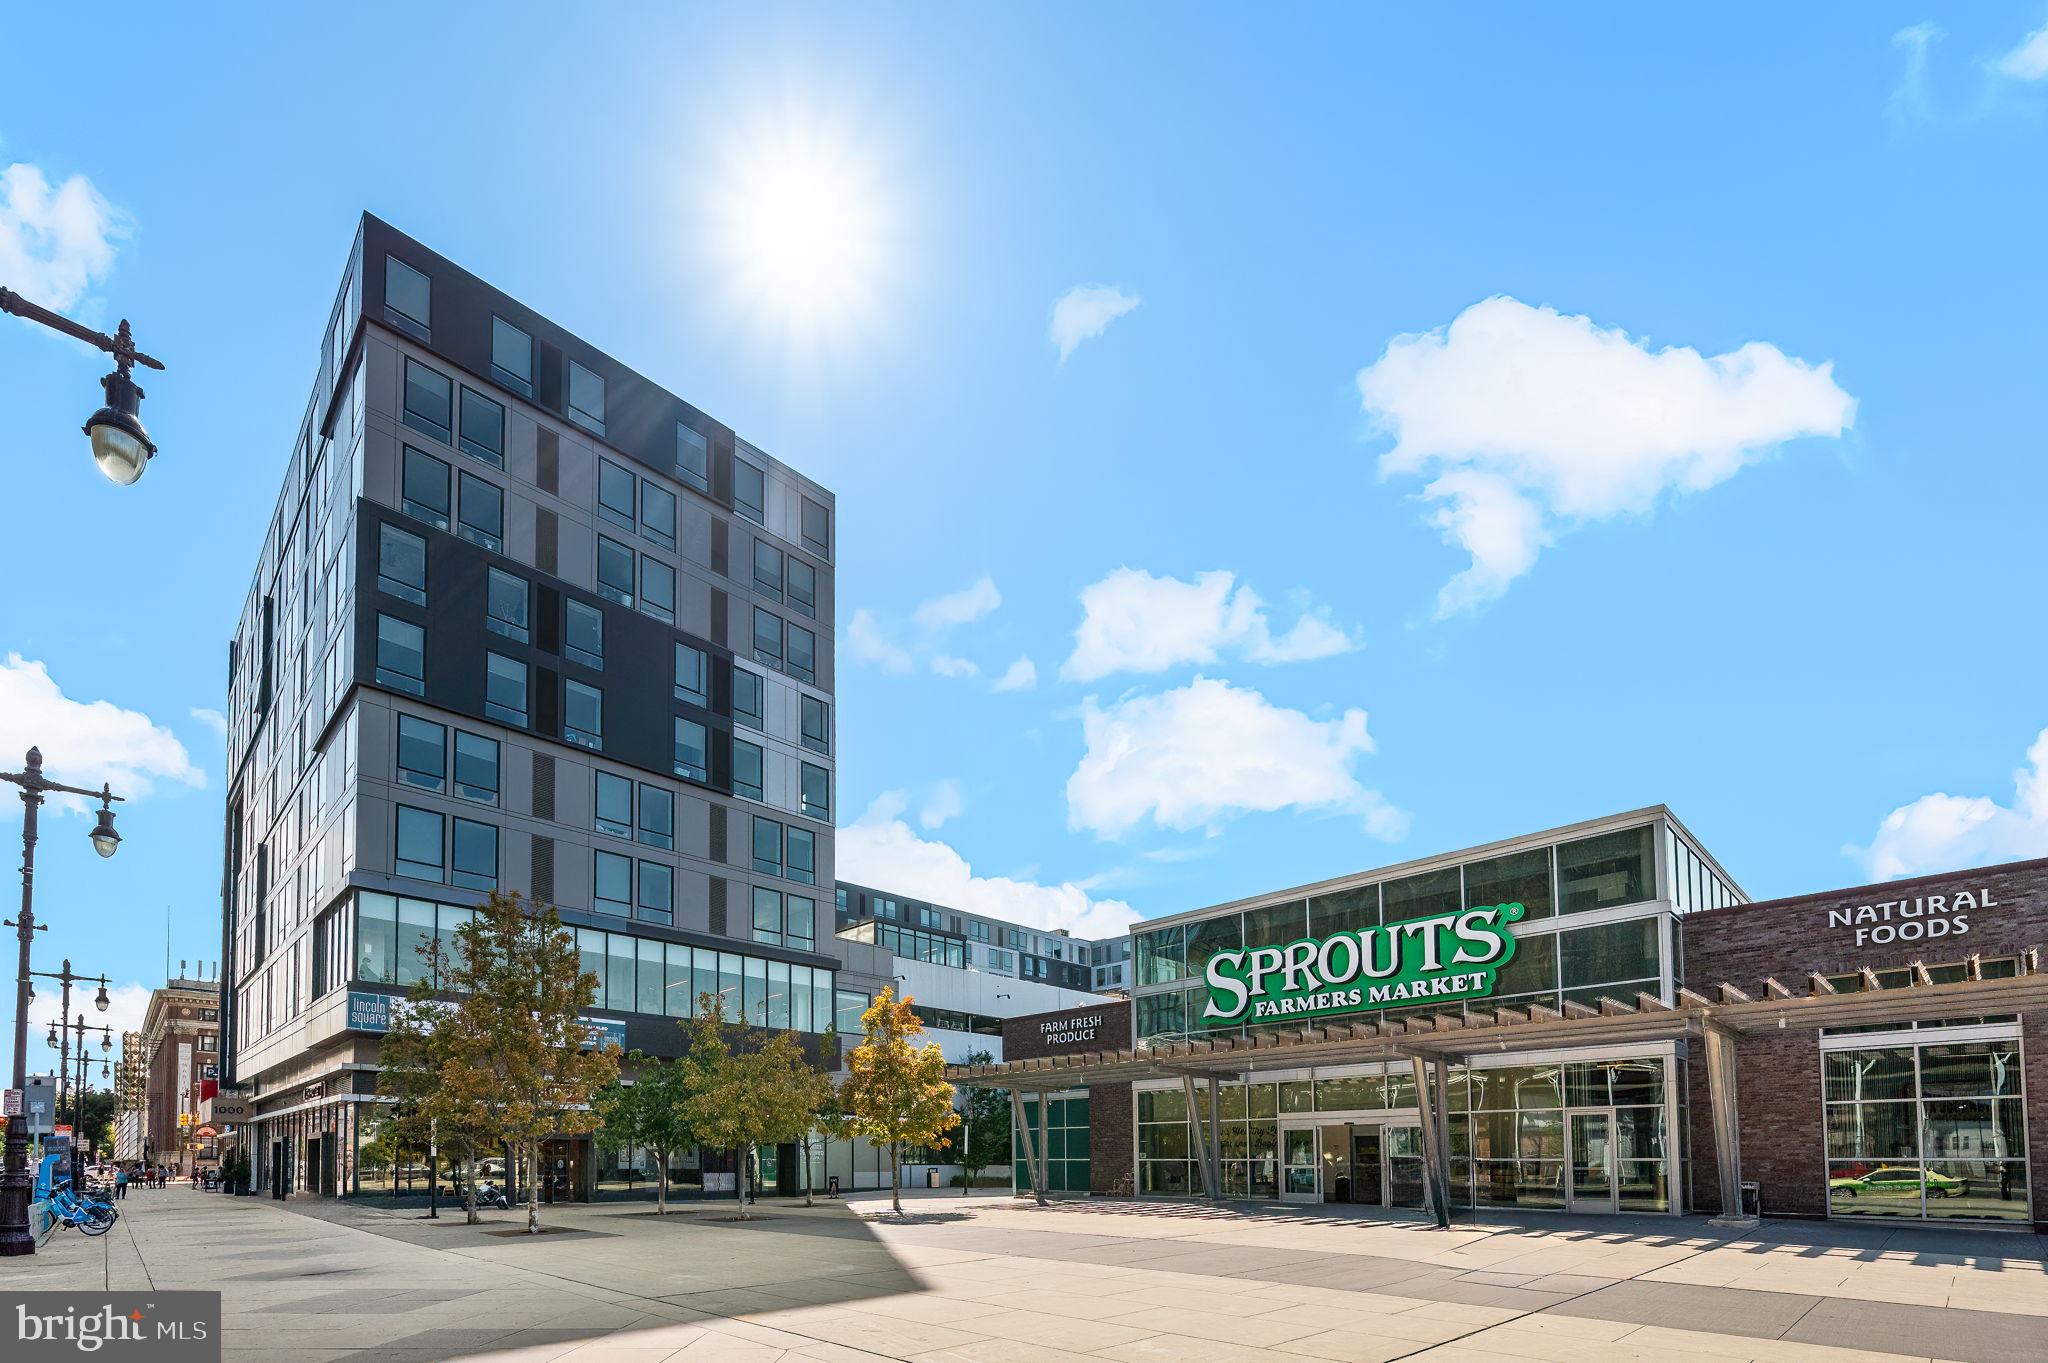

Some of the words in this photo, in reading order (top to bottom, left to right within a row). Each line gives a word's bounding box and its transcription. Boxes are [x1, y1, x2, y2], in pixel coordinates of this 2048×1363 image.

[1828, 888, 1998, 928] NATURAL
[1856, 915, 1970, 947] FOODS
[1203, 908, 1502, 1018] SPROUTS
[1255, 988, 1362, 1017] FARMERS
[1368, 972, 1487, 1003] MARKET
[353, 997, 386, 1014] lincoln
[351, 1011, 387, 1028] square
[1040, 1020, 1068, 1034] FARM
[1071, 1015, 1102, 1030] FRESH
[1047, 1028, 1096, 1045] PRODUCE
[214, 1105, 244, 1115] 1000
